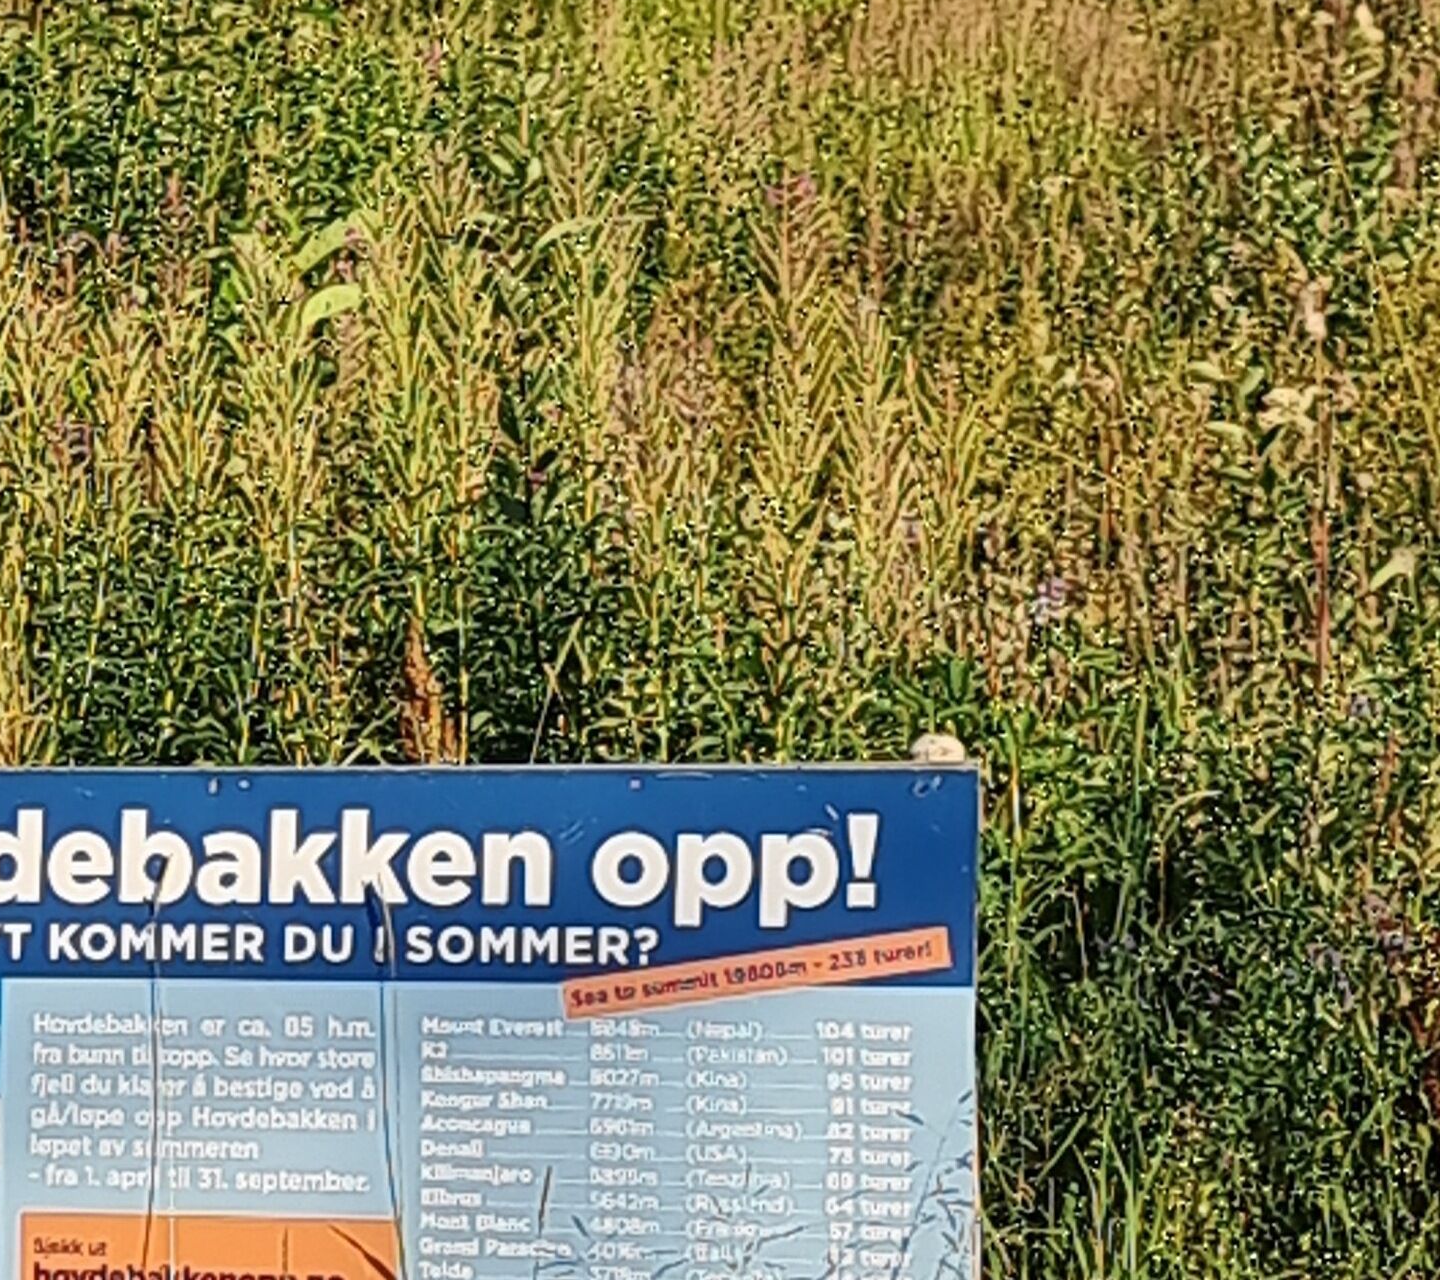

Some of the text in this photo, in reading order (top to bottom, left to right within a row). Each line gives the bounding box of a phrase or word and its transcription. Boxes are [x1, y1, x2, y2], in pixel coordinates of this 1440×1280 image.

[591, 812, 879, 928] opp!
[49, 922, 264, 962] KOMMER
[284, 924, 354, 963] DU
[406, 926, 659, 967] SOMMER?
[570, 987, 609, 1009] Sea
[614, 984, 637, 1002] to
[200, 1017, 224, 1037] er
[238, 1017, 272, 1037] ca.
[421, 1017, 485, 1036] Mount
[489, 1017, 564, 1038] Everest
[816, 1022, 856, 1040] 104
[860, 1023, 913, 1041] turer
[33, 1042, 62, 1064] fra
[68, 1043, 125, 1066] bunn
[224, 1046, 254, 1068] Se
[259, 1047, 311, 1070] hvor
[317, 1049, 376, 1070] store
[686, 1046, 789, 1066] (Pakistan)
[822, 1047, 856, 1066] 101
[860, 1048, 913, 1067] turer
[31, 1074, 76, 1099] fjell
[80, 1075, 112, 1097] du
[117, 1075, 188, 1099] klaer
[213, 1076, 303, 1101] bestige
[309, 1079, 354, 1101] ved
[360, 1078, 376, 1101] å
[685, 1070, 748, 1091] (Kina)
[860, 1073, 913, 1092] turer
[192, 1108, 357, 1131] Hovdebakken
[860, 1124, 913, 1142] turer
[30, 1135, 92, 1160] løpet
[98, 1139, 125, 1158] av
[685, 1144, 749, 1165] (USA)
[44, 1165, 78, 1188] fra
[84, 1166, 101, 1187] 1.
[168, 1168, 191, 1189] til
[198, 1168, 228, 1190] 31.
[235, 1170, 370, 1193] september.
